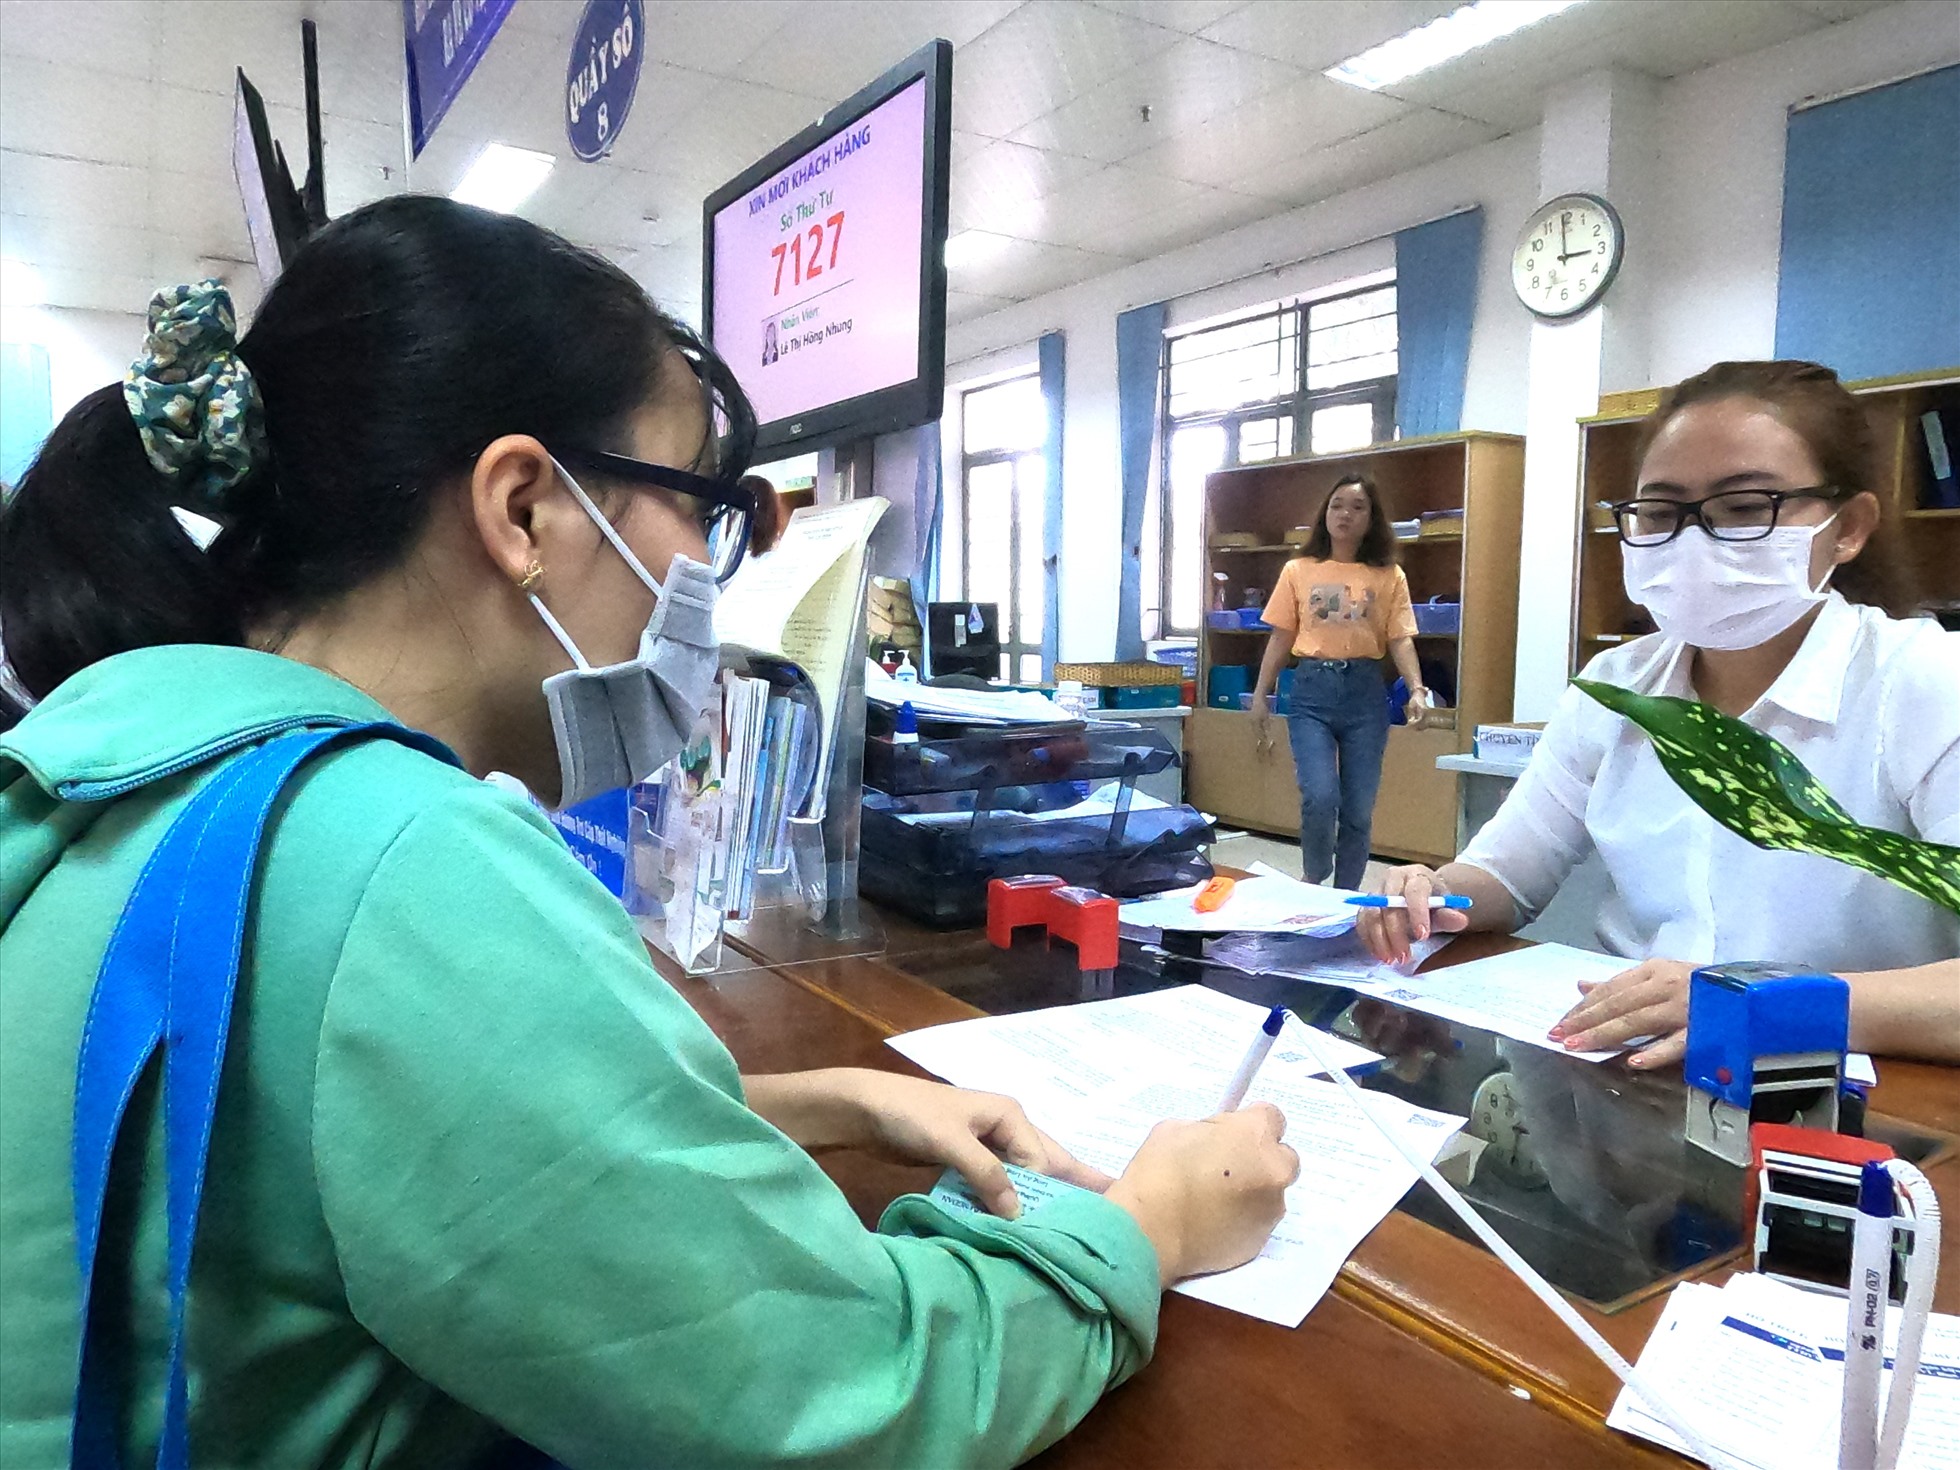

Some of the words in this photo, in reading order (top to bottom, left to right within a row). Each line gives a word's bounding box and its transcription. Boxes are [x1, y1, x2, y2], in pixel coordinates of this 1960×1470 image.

[597, 101, 609, 142] 8
[748, 193, 766, 217] XIN
[834, 124, 871, 165] HÀNG
[1561, 211, 1573, 225] 2
[1543, 221, 1553, 236] 11
[1592, 224, 1602, 237] 2
[1531, 238, 1544, 252] 10
[1597, 241, 1606, 255] 3
[771, 210, 845, 297] 7127
[1526, 258, 1535, 272] 9
[1590, 262, 1599, 275] 4
[1531, 275, 1540, 289] 8
[1578, 278, 1587, 292] 5
[1544, 286, 1553, 300] 7
[1560, 288, 1569, 301] 6
[825, 318, 853, 335] Nhung
